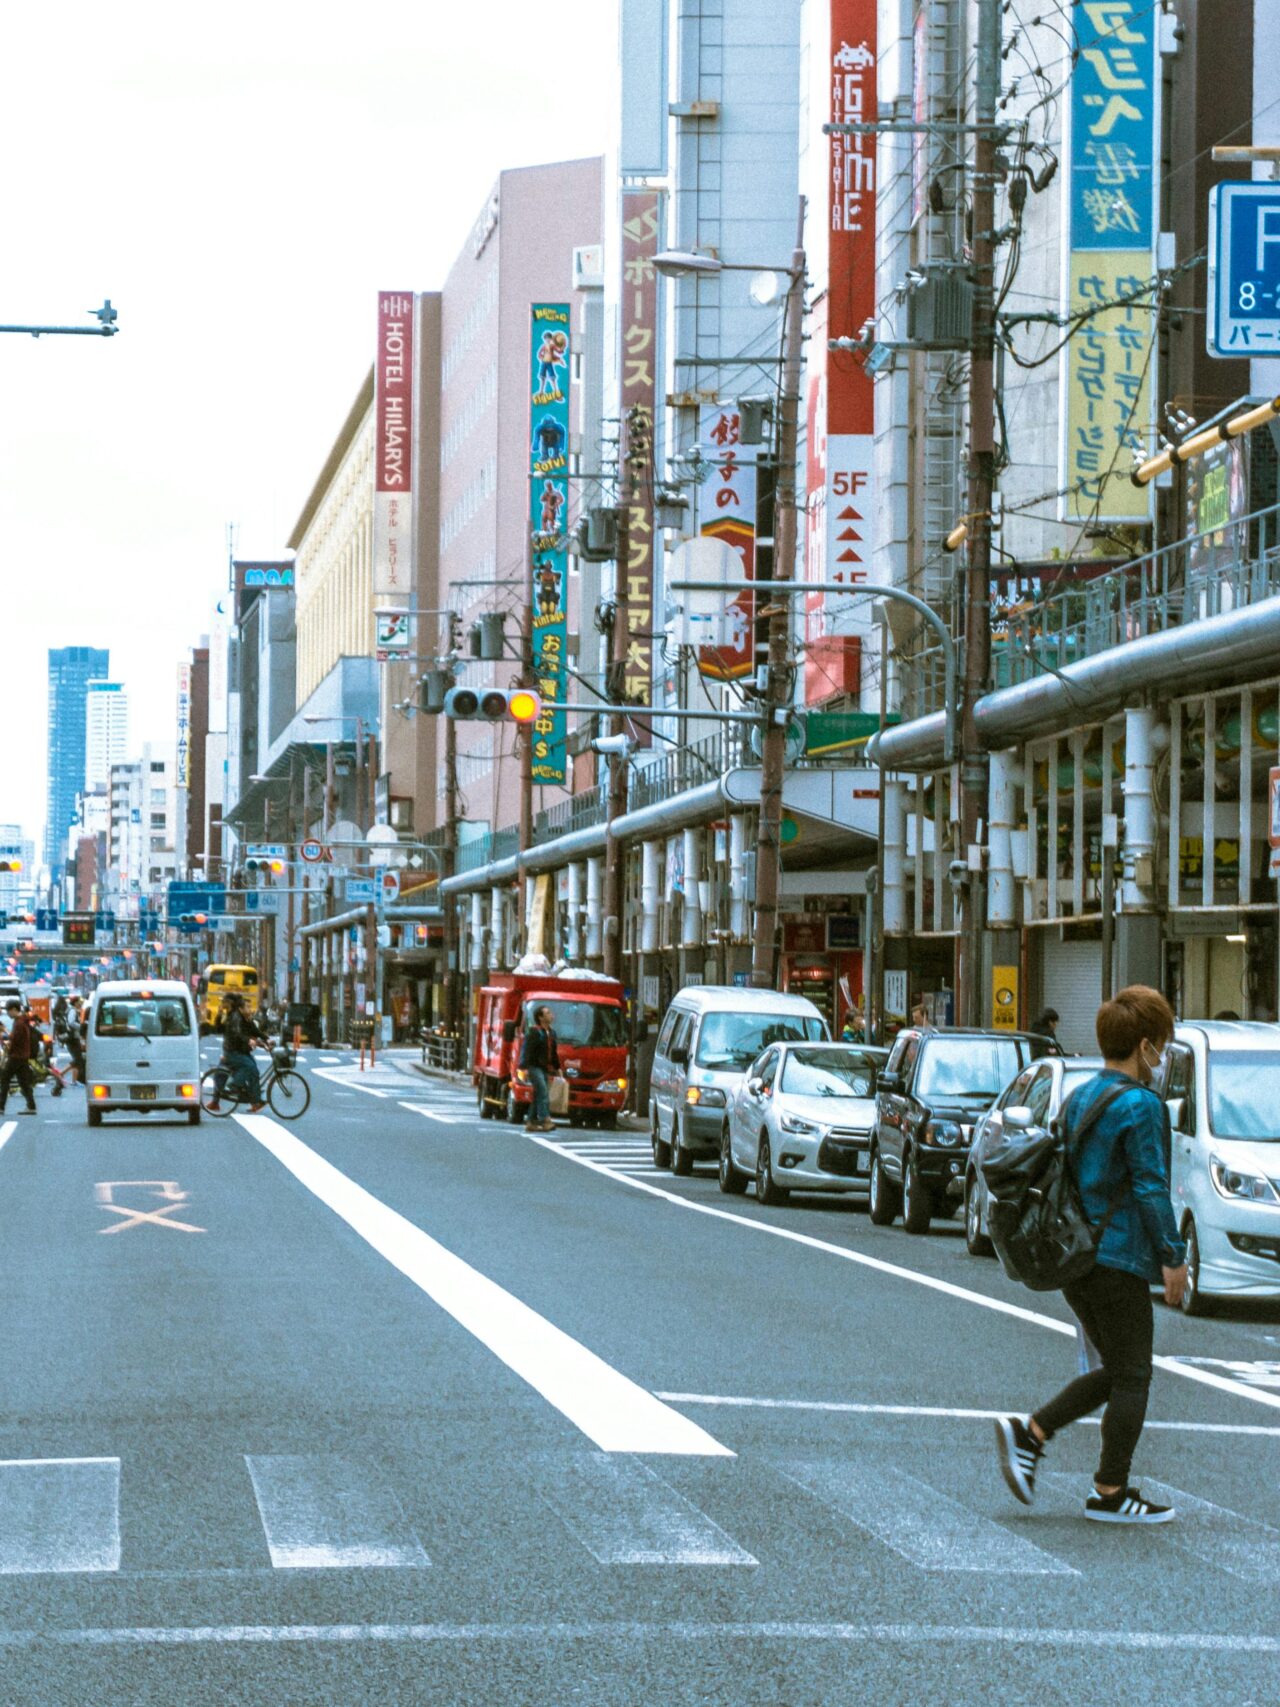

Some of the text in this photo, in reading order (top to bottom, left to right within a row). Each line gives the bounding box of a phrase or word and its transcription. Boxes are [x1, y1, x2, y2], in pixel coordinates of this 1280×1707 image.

[624, 256, 655, 387] ボークス
[384, 322, 408, 486] HOTEL HILLARYS
[832, 471, 868, 496] 5F
